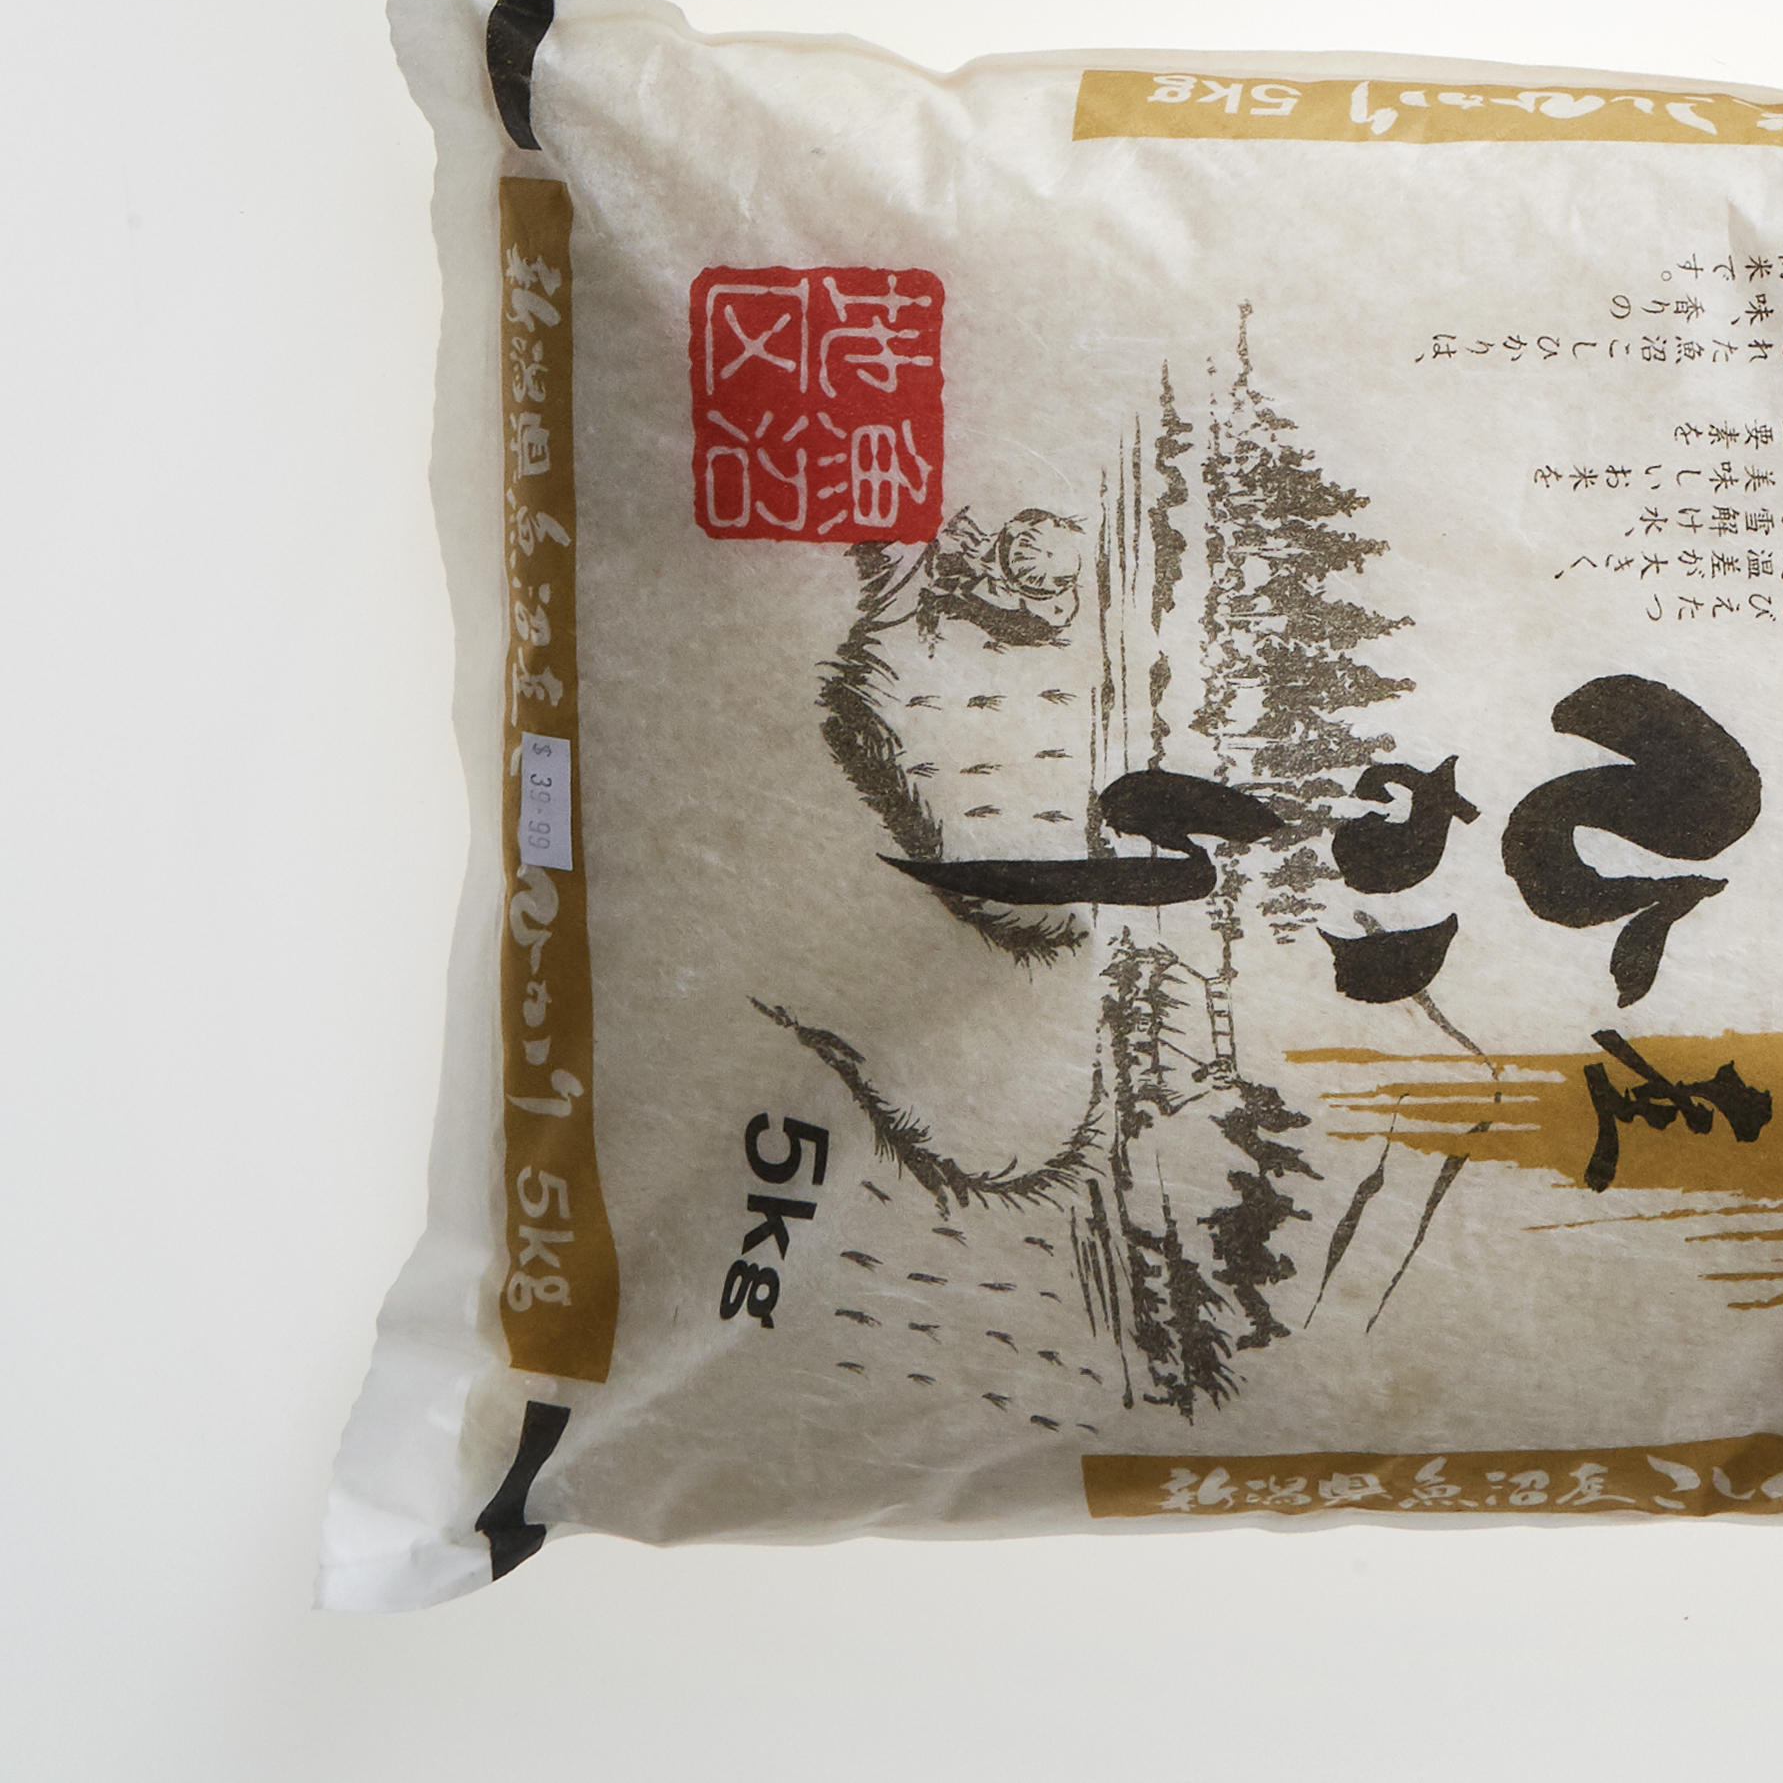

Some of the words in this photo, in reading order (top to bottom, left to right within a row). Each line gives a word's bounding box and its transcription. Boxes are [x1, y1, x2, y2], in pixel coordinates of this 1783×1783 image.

[1146, 74, 1304, 118] 5kg
[504, 1165, 574, 1314] 5kg
[719, 1109, 831, 1331] 5kg
